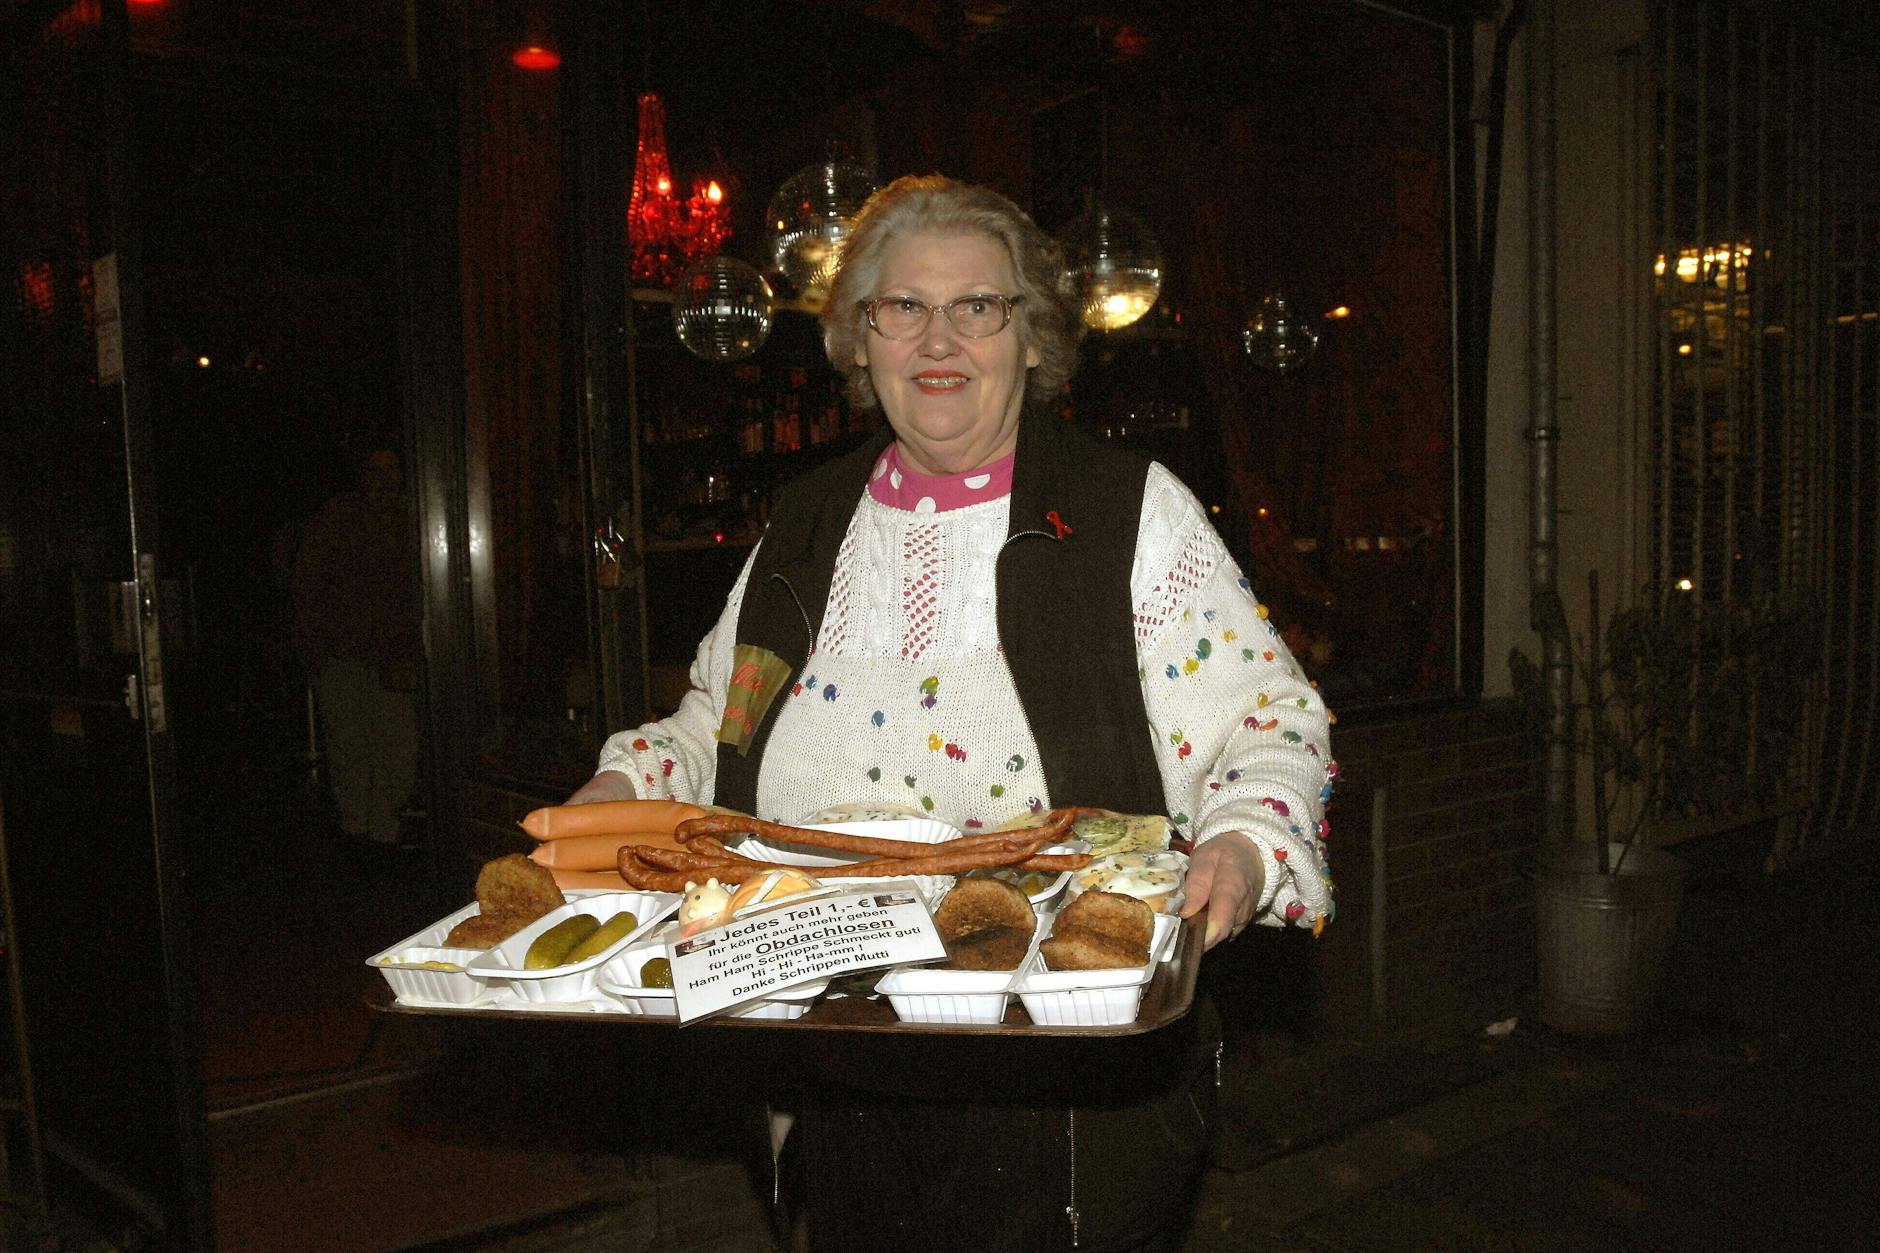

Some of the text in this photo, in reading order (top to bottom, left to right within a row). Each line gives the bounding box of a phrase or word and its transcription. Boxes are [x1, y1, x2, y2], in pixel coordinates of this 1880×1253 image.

[709, 909, 888, 957] Ihr könnt auch mehr geben
[720, 918, 780, 942] Jedes
[785, 906, 821, 921] Teil
[858, 898, 871, 908] €
[689, 974, 720, 990] Ham
[724, 962, 754, 978] Ham
[758, 944, 819, 966] Schrippe
[823, 930, 892, 948] Schmeckt
[709, 918, 895, 971] für die Obdachlosen
[752, 967, 766, 979] Hi
[779, 959, 793, 970] Hi
[806, 945, 855, 962] Ha-mm
[732, 950, 889, 997] Danke Schrippen Mutti
